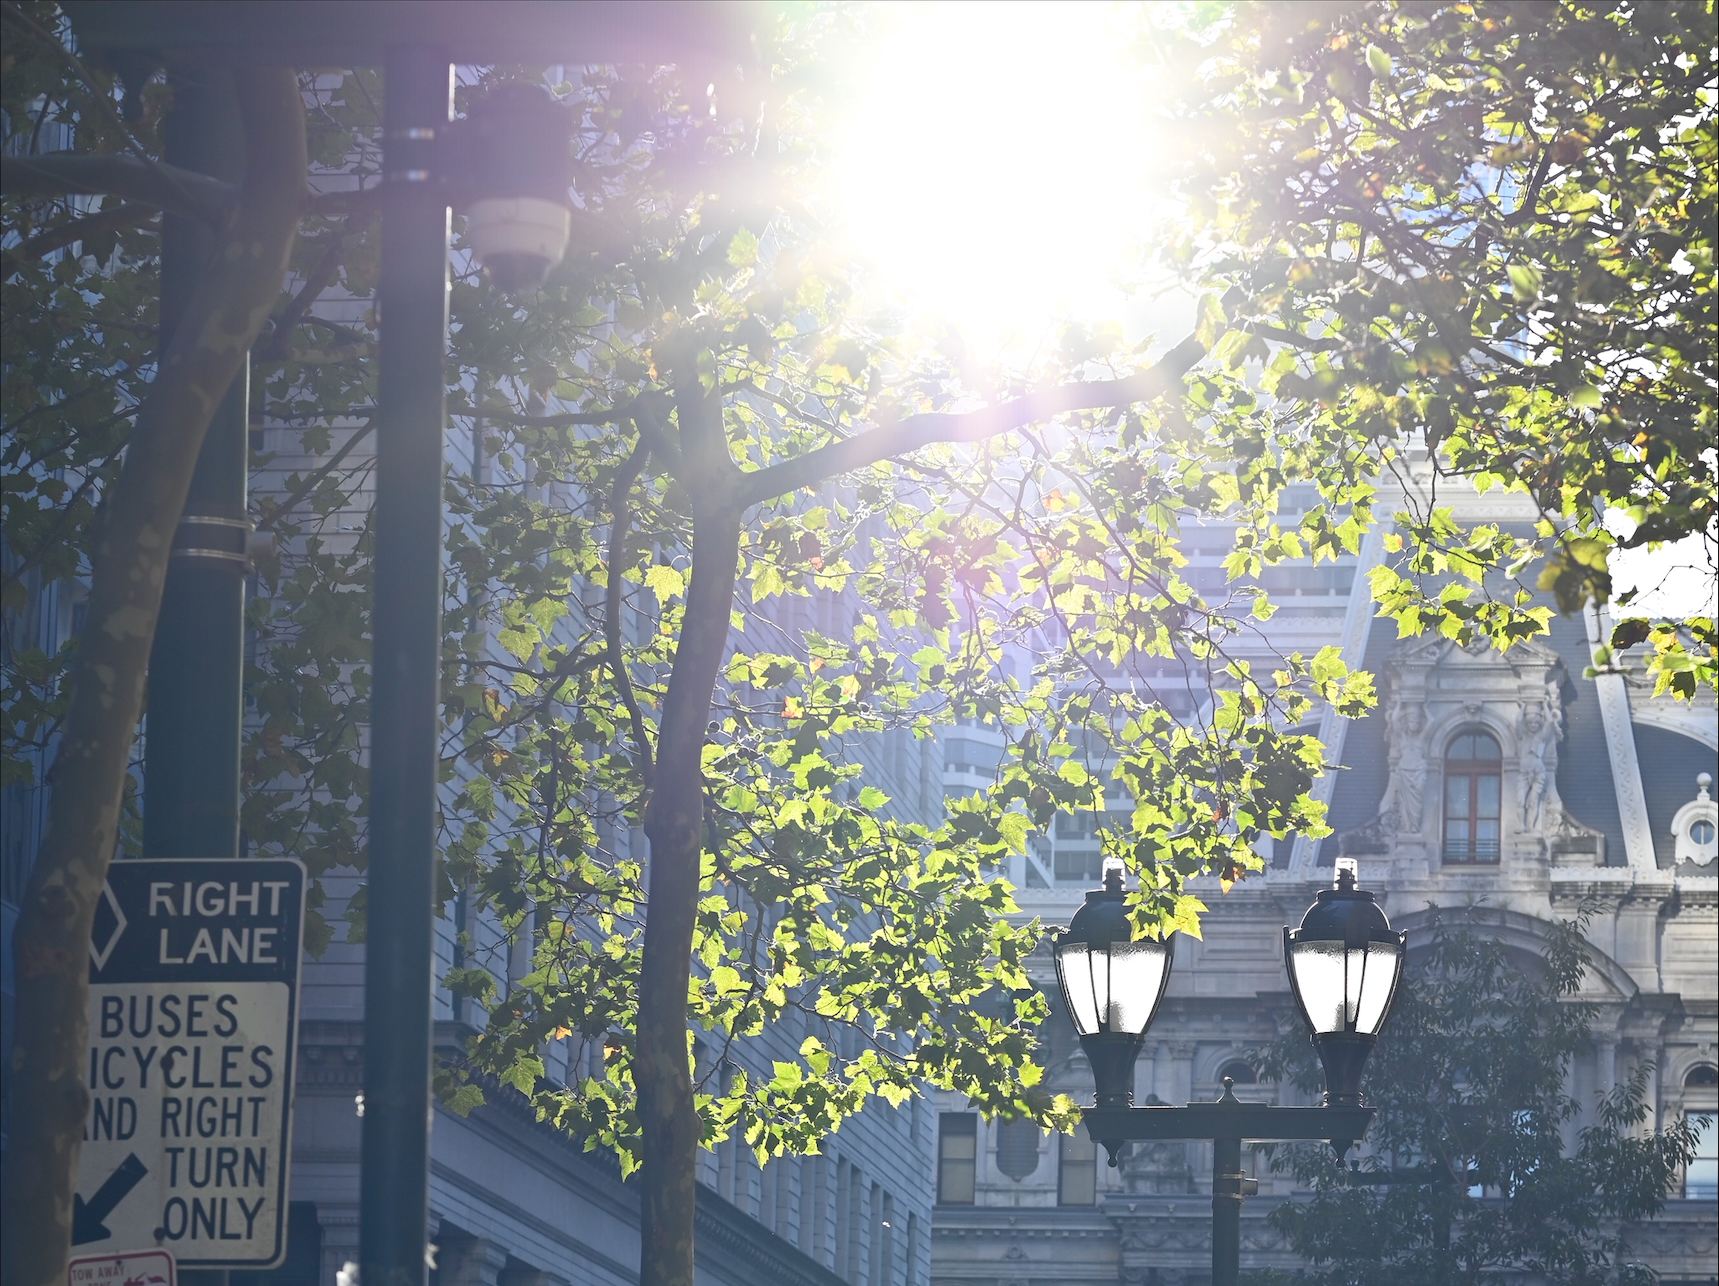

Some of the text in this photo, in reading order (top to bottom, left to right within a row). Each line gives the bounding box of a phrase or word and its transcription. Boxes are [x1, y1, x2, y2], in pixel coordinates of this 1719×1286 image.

[149, 882, 289, 916] RIGHT
[159, 928, 278, 964] LANE
[100, 995, 239, 1038] BUSES
[89, 1046, 273, 1089] ICYCLES
[84, 1096, 266, 1140] ND RIGHT
[165, 1147, 267, 1188] TURN
[163, 1197, 266, 1240] ONLY
[72, 1264, 126, 1281] TOW AWAY
